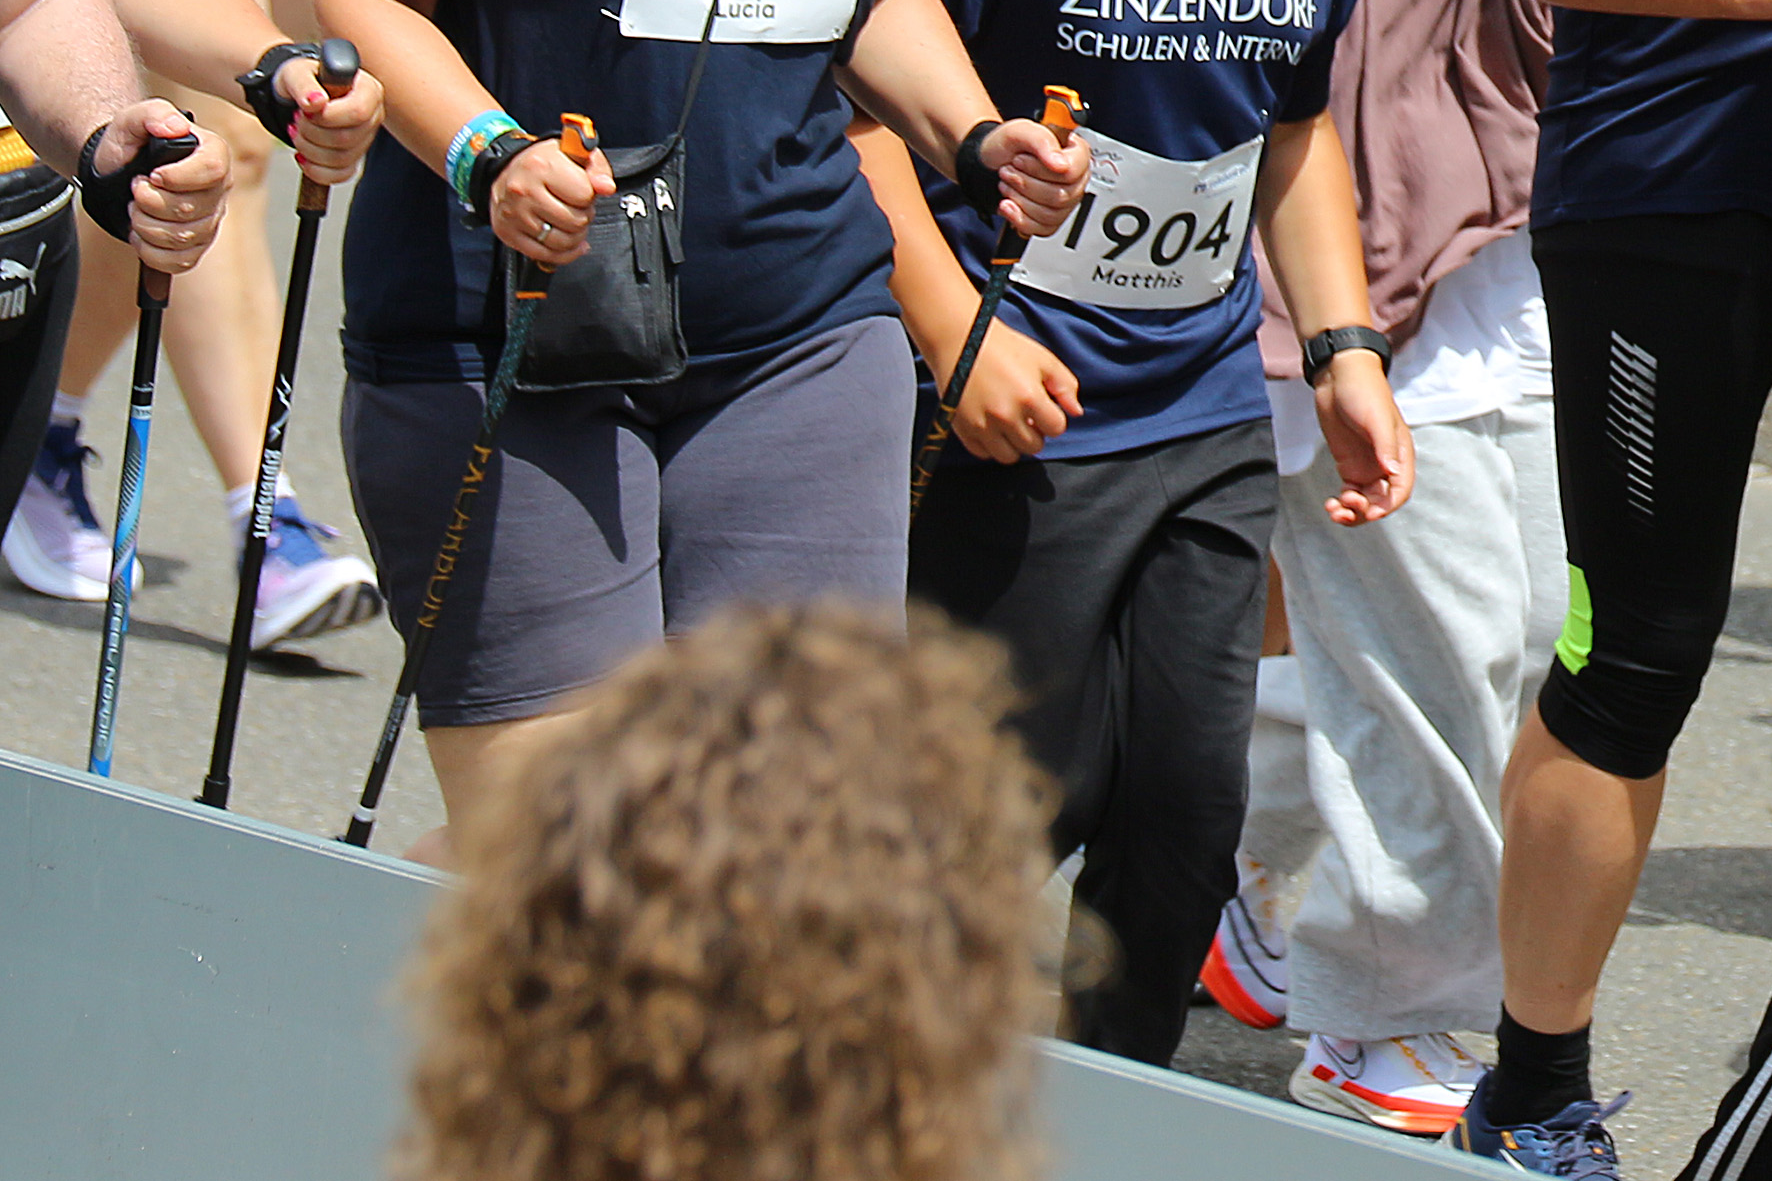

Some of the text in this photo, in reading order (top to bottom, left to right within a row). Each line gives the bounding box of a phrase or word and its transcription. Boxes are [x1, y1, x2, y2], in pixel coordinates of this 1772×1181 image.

[1056, 22, 1301, 66] SCHULEN & INTERN
[1063, 191, 1234, 267] 1904
[1091, 265, 1184, 290] Matthis
